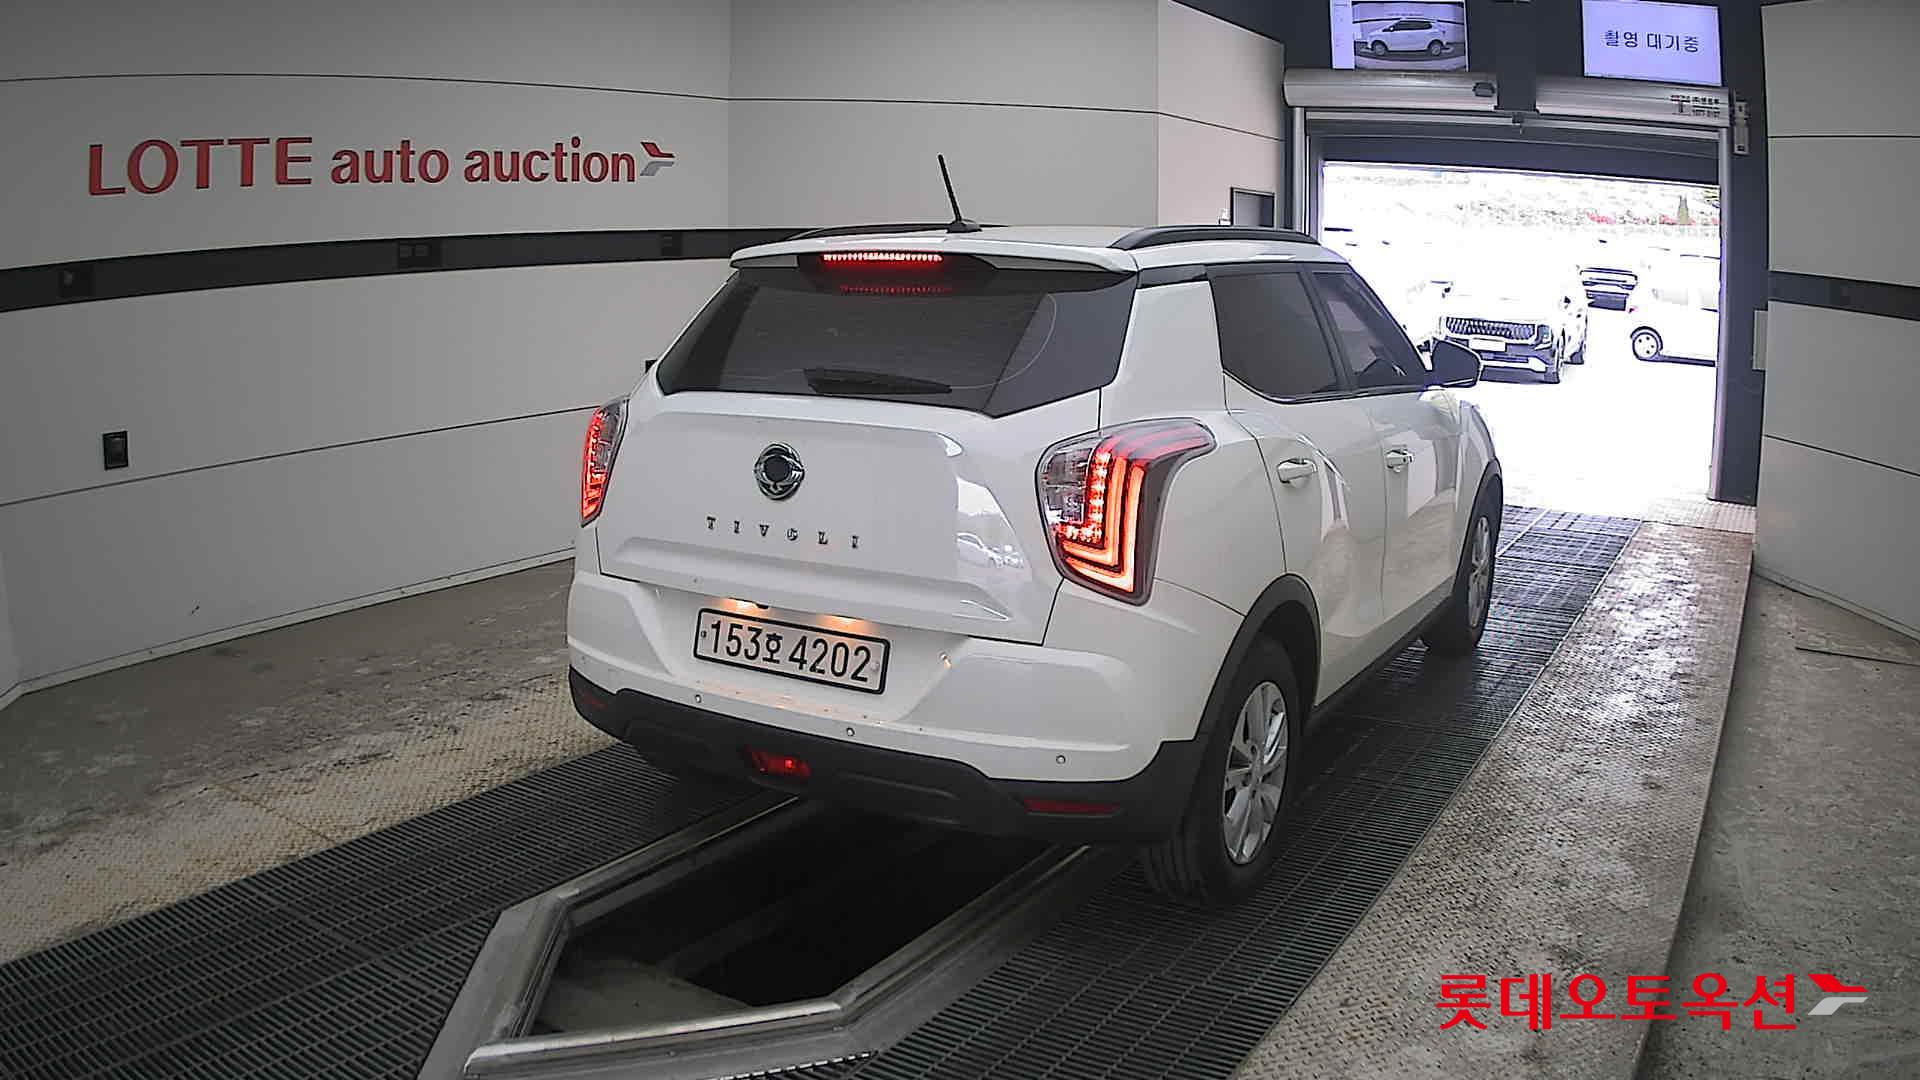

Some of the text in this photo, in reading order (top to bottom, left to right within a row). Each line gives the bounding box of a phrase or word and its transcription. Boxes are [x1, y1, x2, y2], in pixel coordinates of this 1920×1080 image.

[1604, 30, 1700, 53] 촬영 대기중
[88, 136, 637, 196] LOTTE auto auction
[706, 516, 860, 549] TIVOLI
[711, 619, 872, 683] 153호 4202
